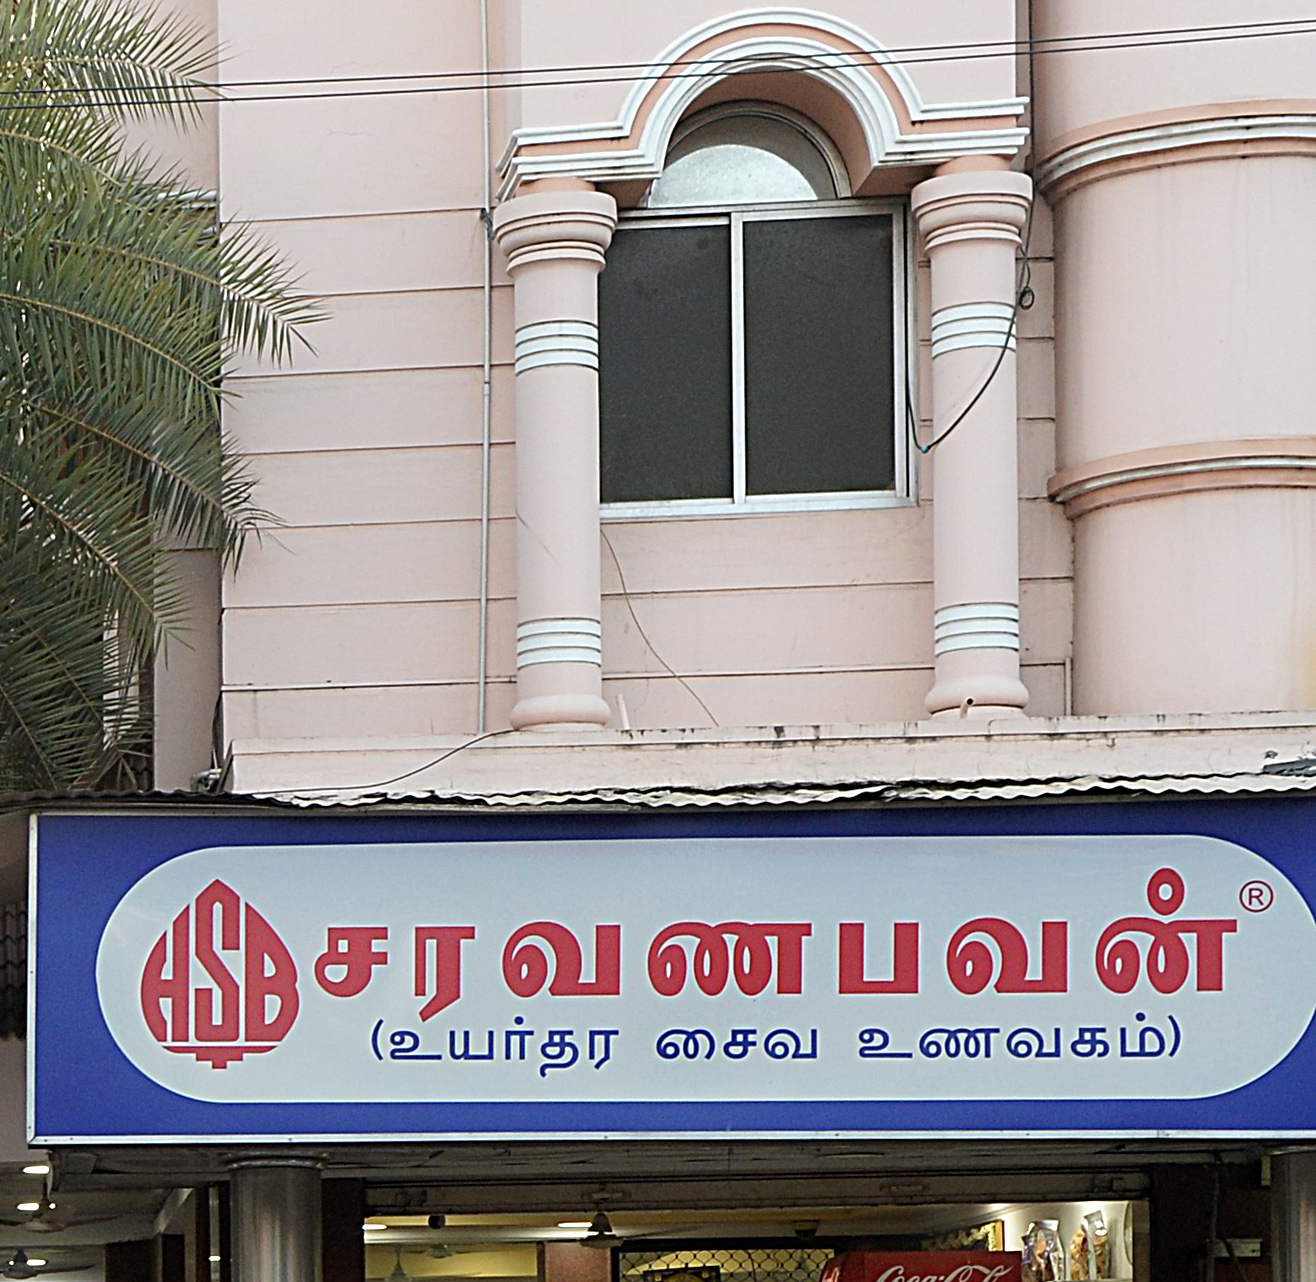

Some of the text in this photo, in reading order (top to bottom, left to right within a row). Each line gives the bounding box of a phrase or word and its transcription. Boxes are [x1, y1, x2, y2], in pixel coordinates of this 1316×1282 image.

[315, 868, 1238, 1021] சரவணபவன்
[371, 1012, 1181, 1079] (உயர்தர சைவ உணவகம்)
